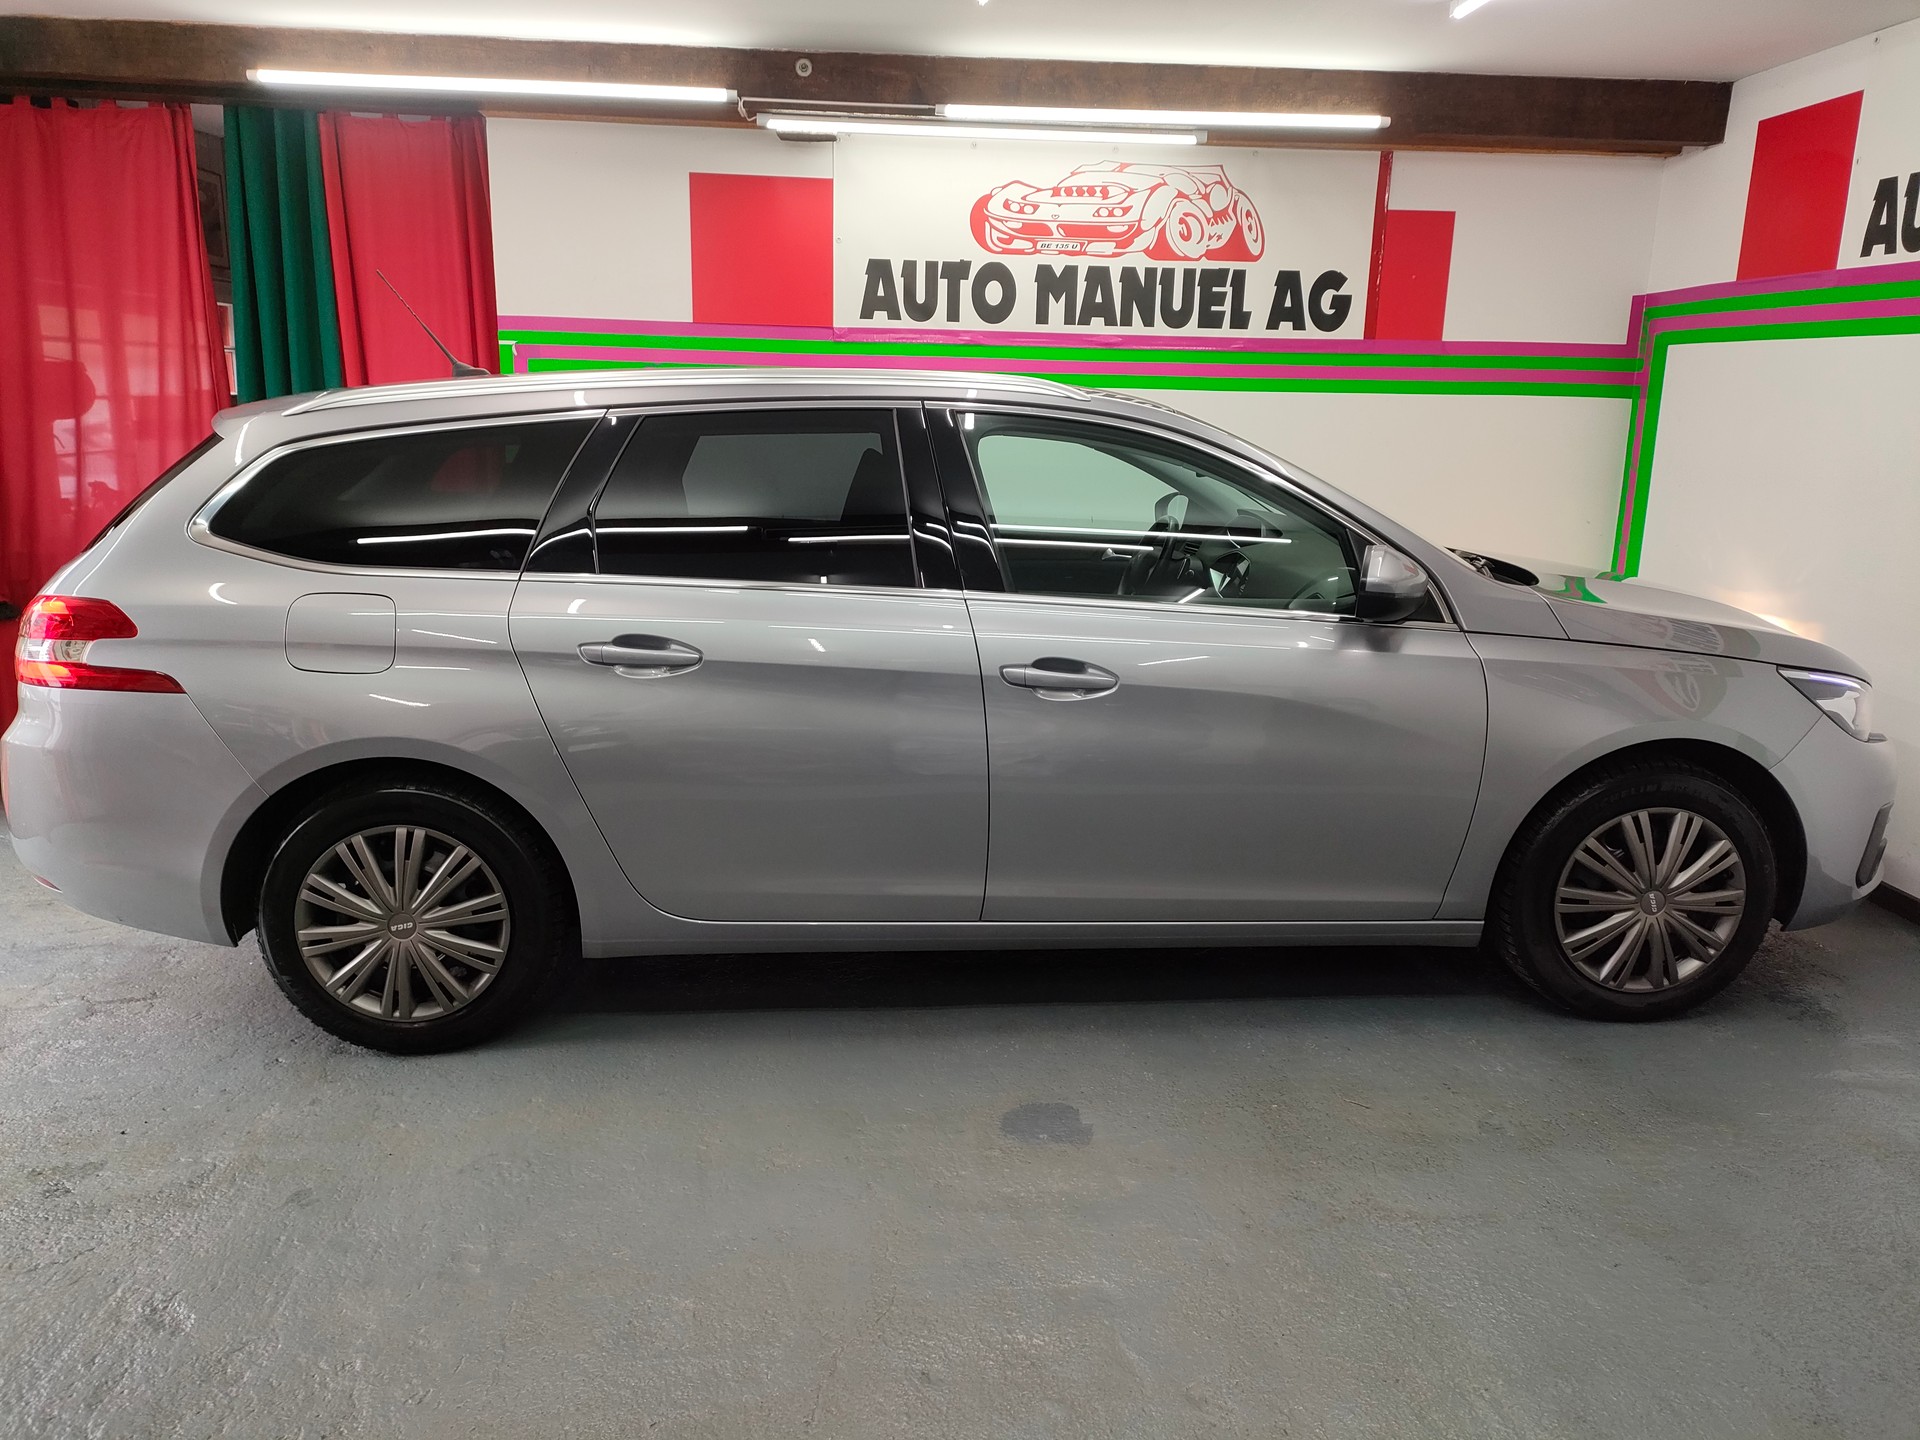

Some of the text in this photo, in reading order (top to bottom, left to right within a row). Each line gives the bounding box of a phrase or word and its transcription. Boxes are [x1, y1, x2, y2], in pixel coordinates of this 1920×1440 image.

[859, 258, 1353, 333] AUTO MANUEL AG
